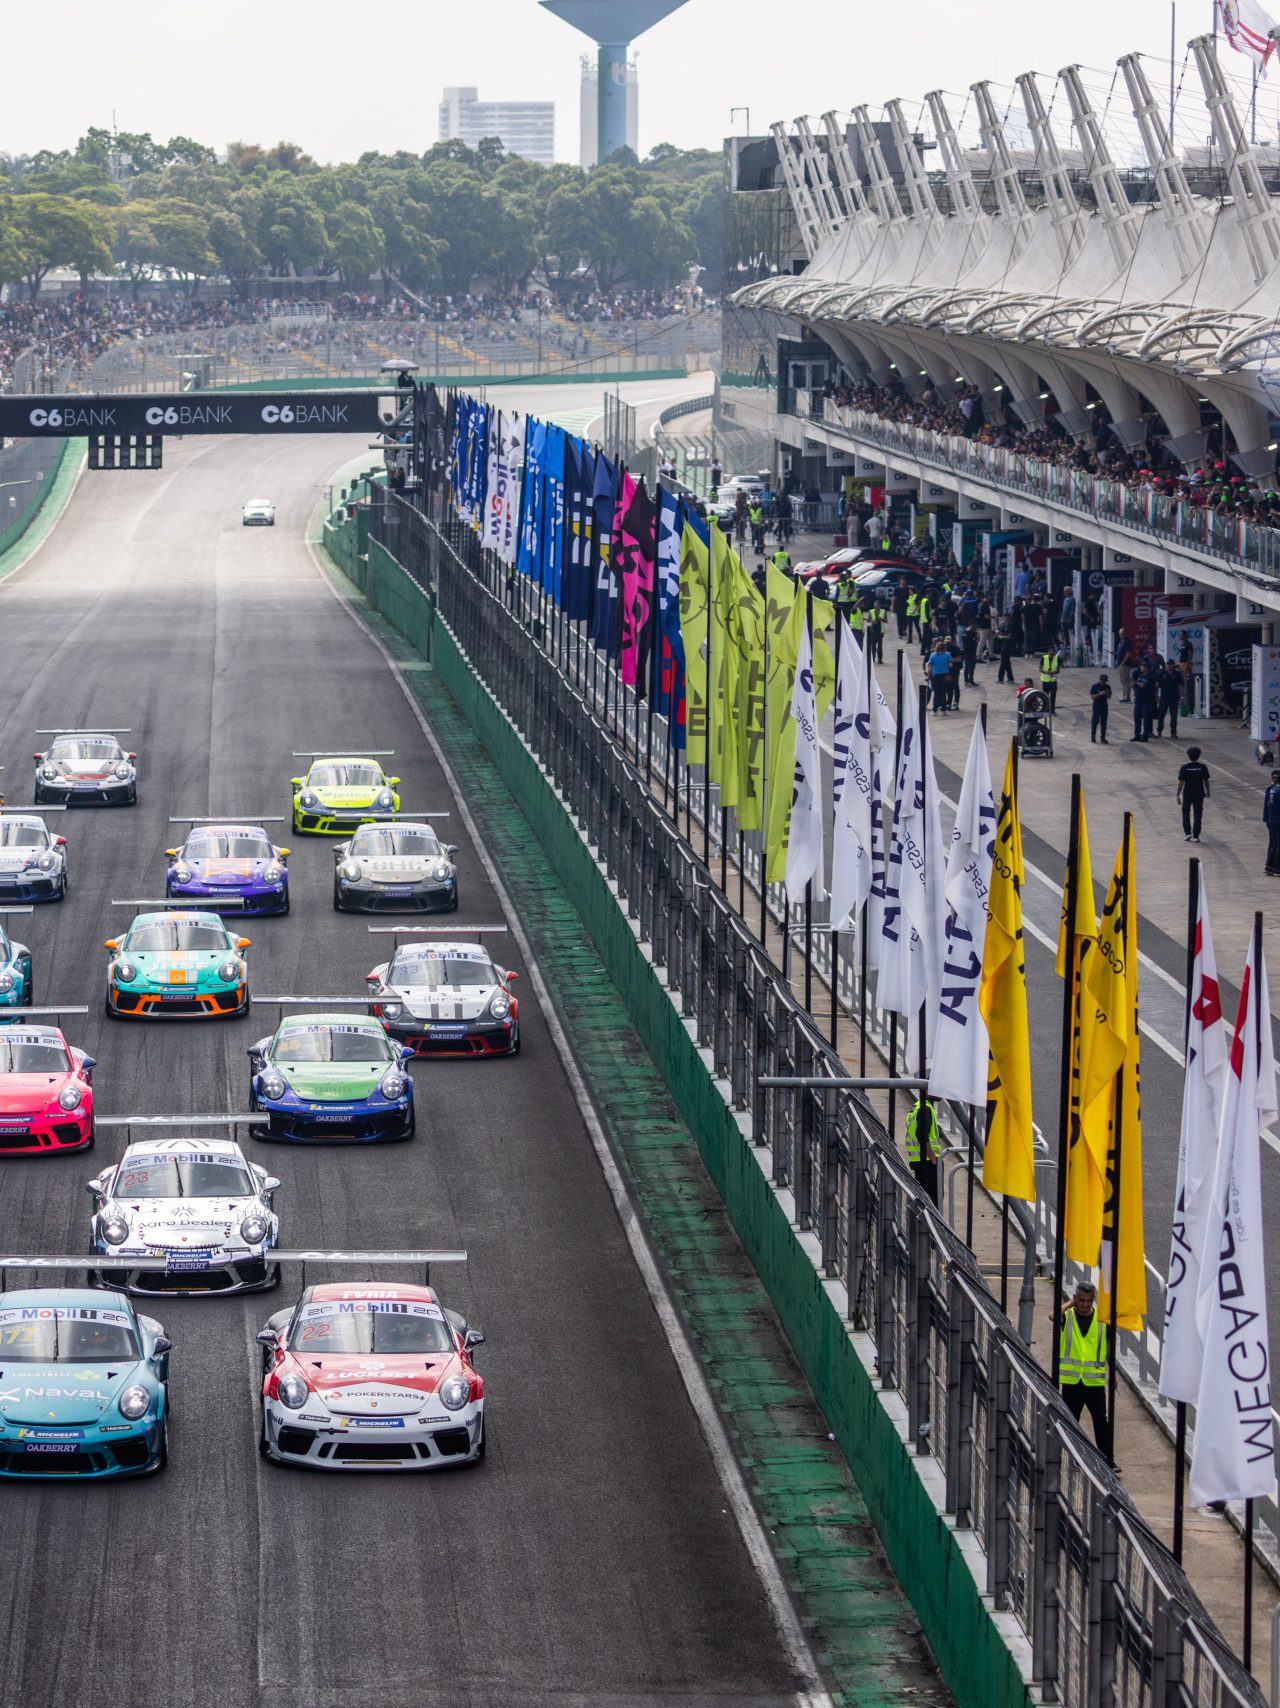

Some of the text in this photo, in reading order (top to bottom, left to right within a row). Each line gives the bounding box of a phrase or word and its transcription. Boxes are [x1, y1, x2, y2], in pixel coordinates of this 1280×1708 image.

[30, 409, 115, 426] C6BANK
[146, 406, 232, 425] C6BANK
[261, 405, 348, 423] C6BANK
[1114, 554, 1131, 562] 09
[1178, 577, 1195, 587] 10
[1250, 605, 1265, 614] 11
[154, 1155, 200, 1164] Mobil
[124, 1172, 149, 1188] 23
[138, 1220, 233, 1229] Agro Dealer
[339, 1303, 390, 1312] Mobil
[22, 1308, 77, 1320] Mobil
[303, 1324, 332, 1342] 22
[27, 1444, 78, 1452] OAKBERRY
